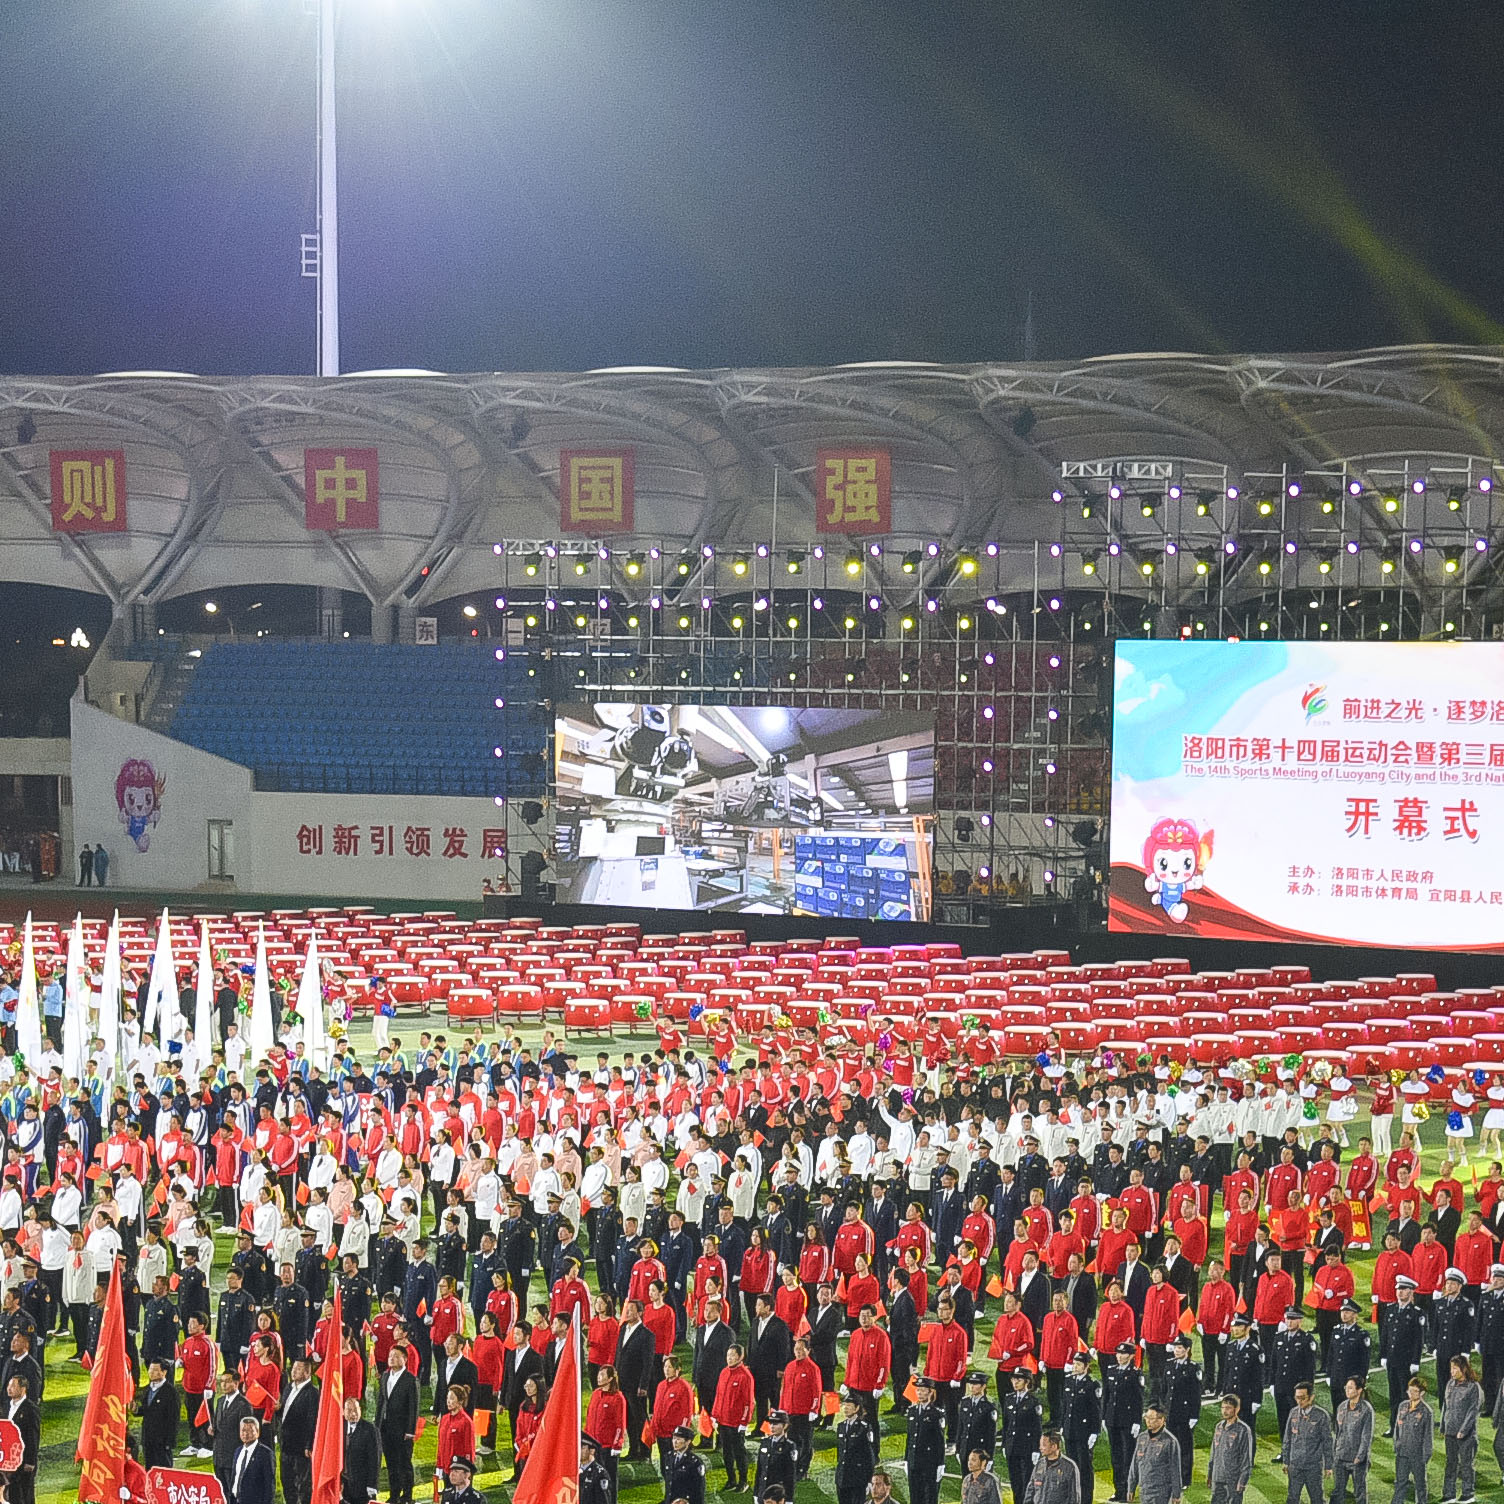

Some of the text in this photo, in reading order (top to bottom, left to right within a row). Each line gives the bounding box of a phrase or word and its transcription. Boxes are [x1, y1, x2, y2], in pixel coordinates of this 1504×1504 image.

[61, 458, 117, 522] 则
[315, 457, 368, 520] 中
[569, 457, 625, 521] 国
[825, 458, 881, 524] 强
[418, 621, 436, 642] 东
[1183, 764, 1204, 774] The
[1207, 765, 1230, 776] 14th
[1233, 765, 1270, 778] Sports
[1272, 767, 1318, 780] Meeting
[1321, 767, 1333, 778] of
[1336, 769, 1385, 782] Luoyang
[1388, 770, 1411, 782] City
[1414, 771, 1436, 782] and
[1440, 771, 1459, 782] the
[1461, 772, 1482, 783] 3rd
[1344, 797, 1479, 840] 开幕式
[296, 823, 508, 861] 创新引领发展
